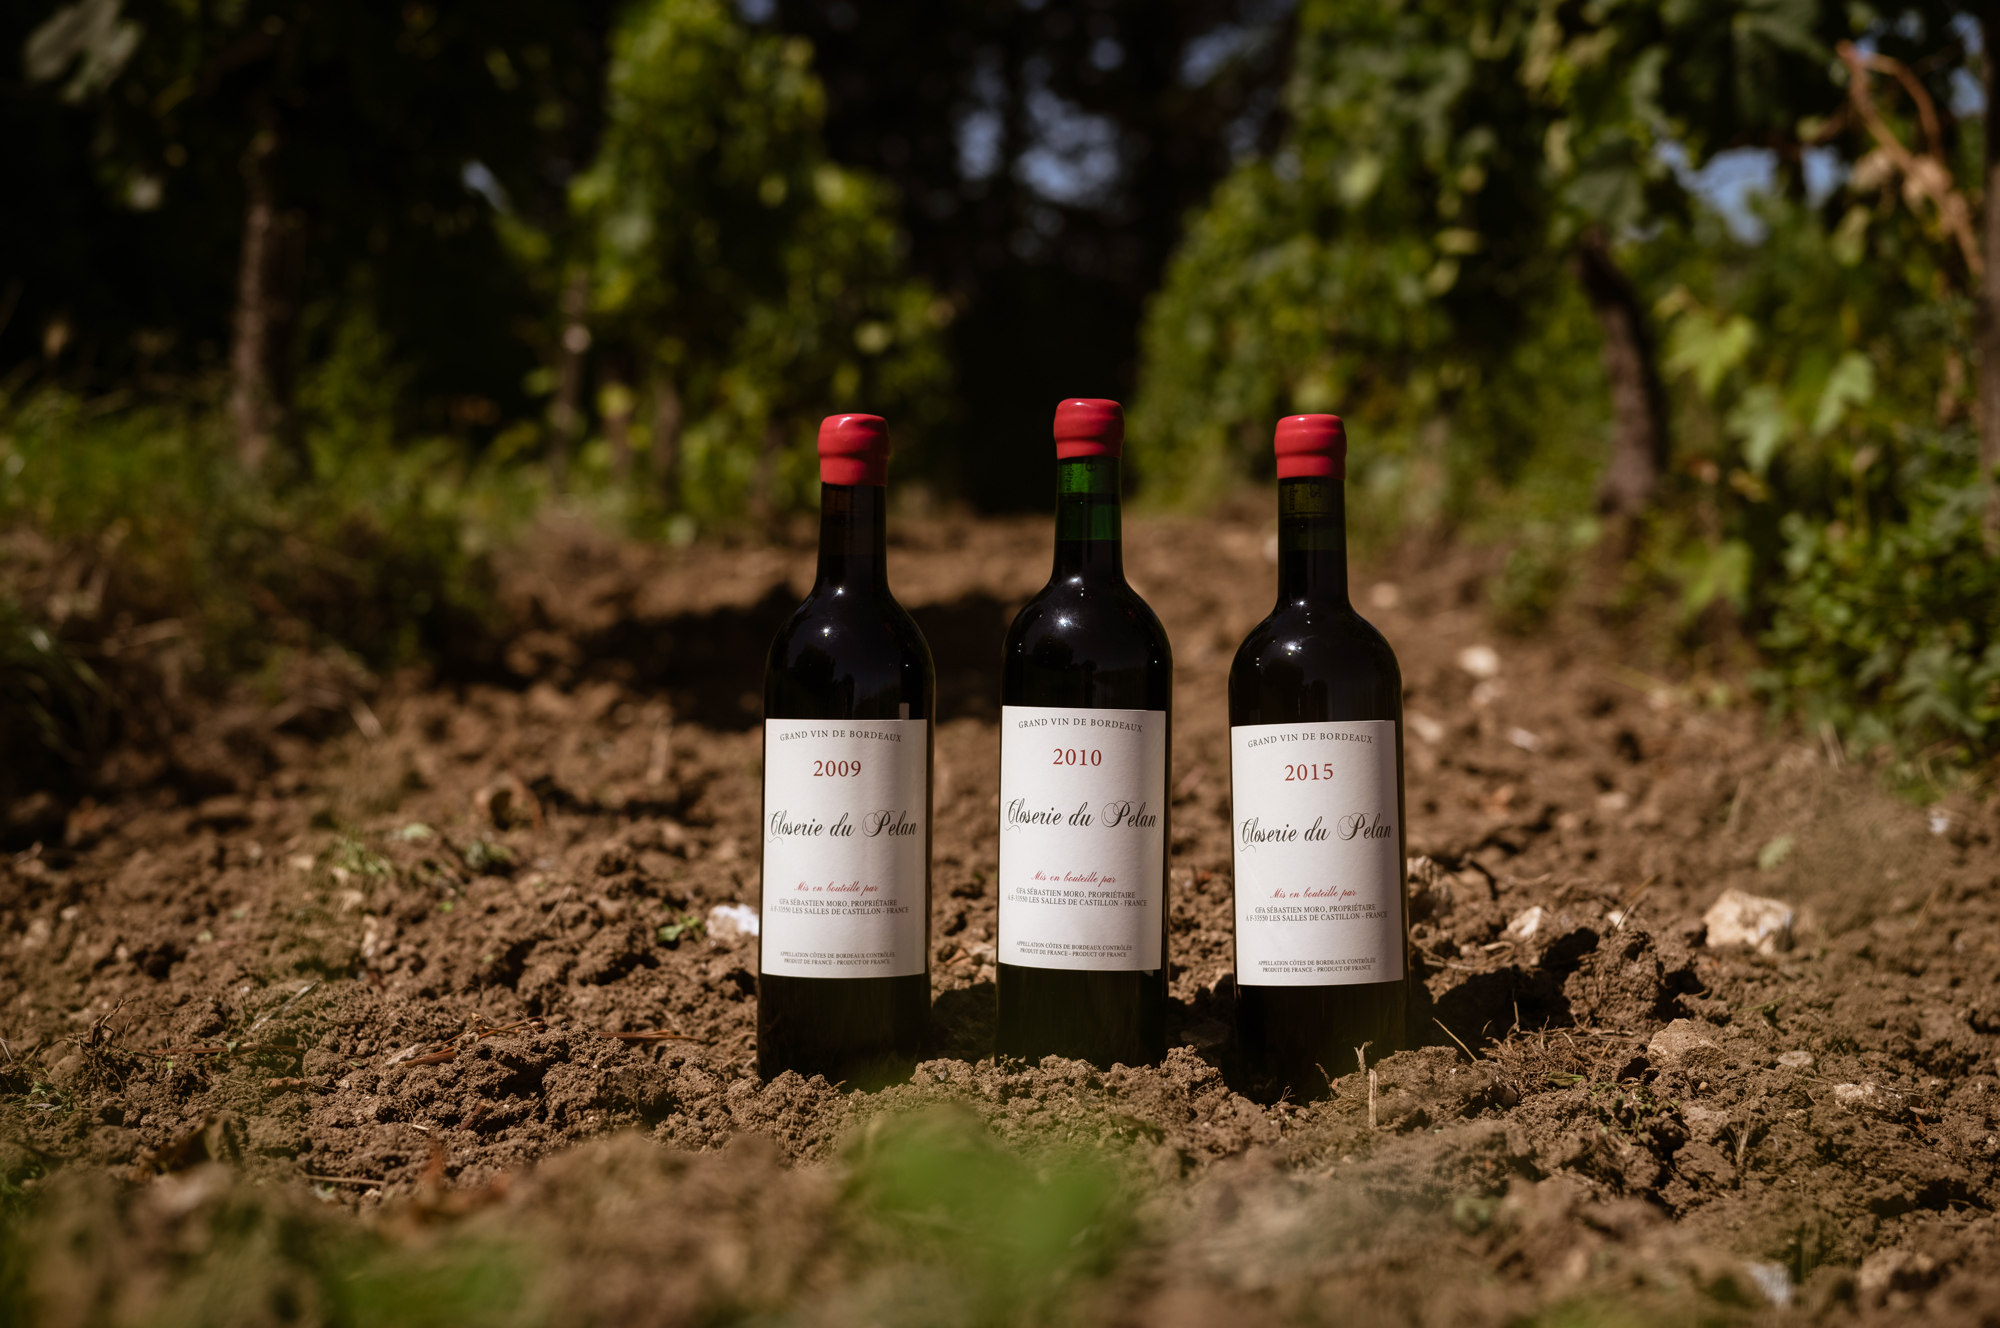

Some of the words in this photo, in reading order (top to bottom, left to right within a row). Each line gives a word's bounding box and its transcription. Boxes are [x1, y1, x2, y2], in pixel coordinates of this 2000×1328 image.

[1019, 719, 1048, 729] GRAND
[1051, 718, 1069, 726] VIN
[1073, 718, 1086, 726] DE
[1090, 719, 1142, 732] BORDEAUX
[780, 731, 808, 741] GRAND
[850, 730, 902, 742] BORDEAUX
[1248, 736, 1277, 748] GRAND
[1280, 734, 1298, 742] VIN
[1302, 733, 1315, 741] DE
[1320, 733, 1373, 743] BORDEAUX
[1053, 749, 1102, 766] 2010
[813, 760, 861, 777] 2009
[1285, 764, 1333, 781] 2015
[1004, 798, 1064, 833] Closerie
[1068, 802, 1095, 826] du
[1101, 800, 1158, 828] Pelan
[767, 810, 825, 845] Closerie
[830, 813, 856, 837] du
[862, 810, 918, 837] Pelan
[1238, 817, 1299, 853] Closerie
[1304, 816, 1330, 841] du
[1337, 813, 1393, 840] Pelan
[1031, 871, 1046, 881] Mis
[1064, 871, 1098, 883] bouteille
[1098, 875, 1116, 887] par
[794, 881, 809, 892] Mis
[826, 881, 860, 892] bouteille
[861, 883, 878, 896] par
[1027, 887, 1061, 897] SÉBASTIEN
[1064, 890, 1086, 898] MORO,
[1088, 890, 1135, 899] PROPRIÉTAIRE
[1270, 888, 1285, 898] Mis
[1303, 886, 1338, 898] bouteille
[1339, 888, 1357, 901] par
[790, 898, 824, 907] SÉBASTIEN
[851, 899, 897, 907] PROPRIÉTAIRE
[1041, 897, 1066, 905] SALLES
[1267, 905, 1301, 913] SÉBASTIEN
[1329, 903, 1376, 912] PROPRIÉTAIRE
[1321, 912, 1360, 921] CASTILLON
